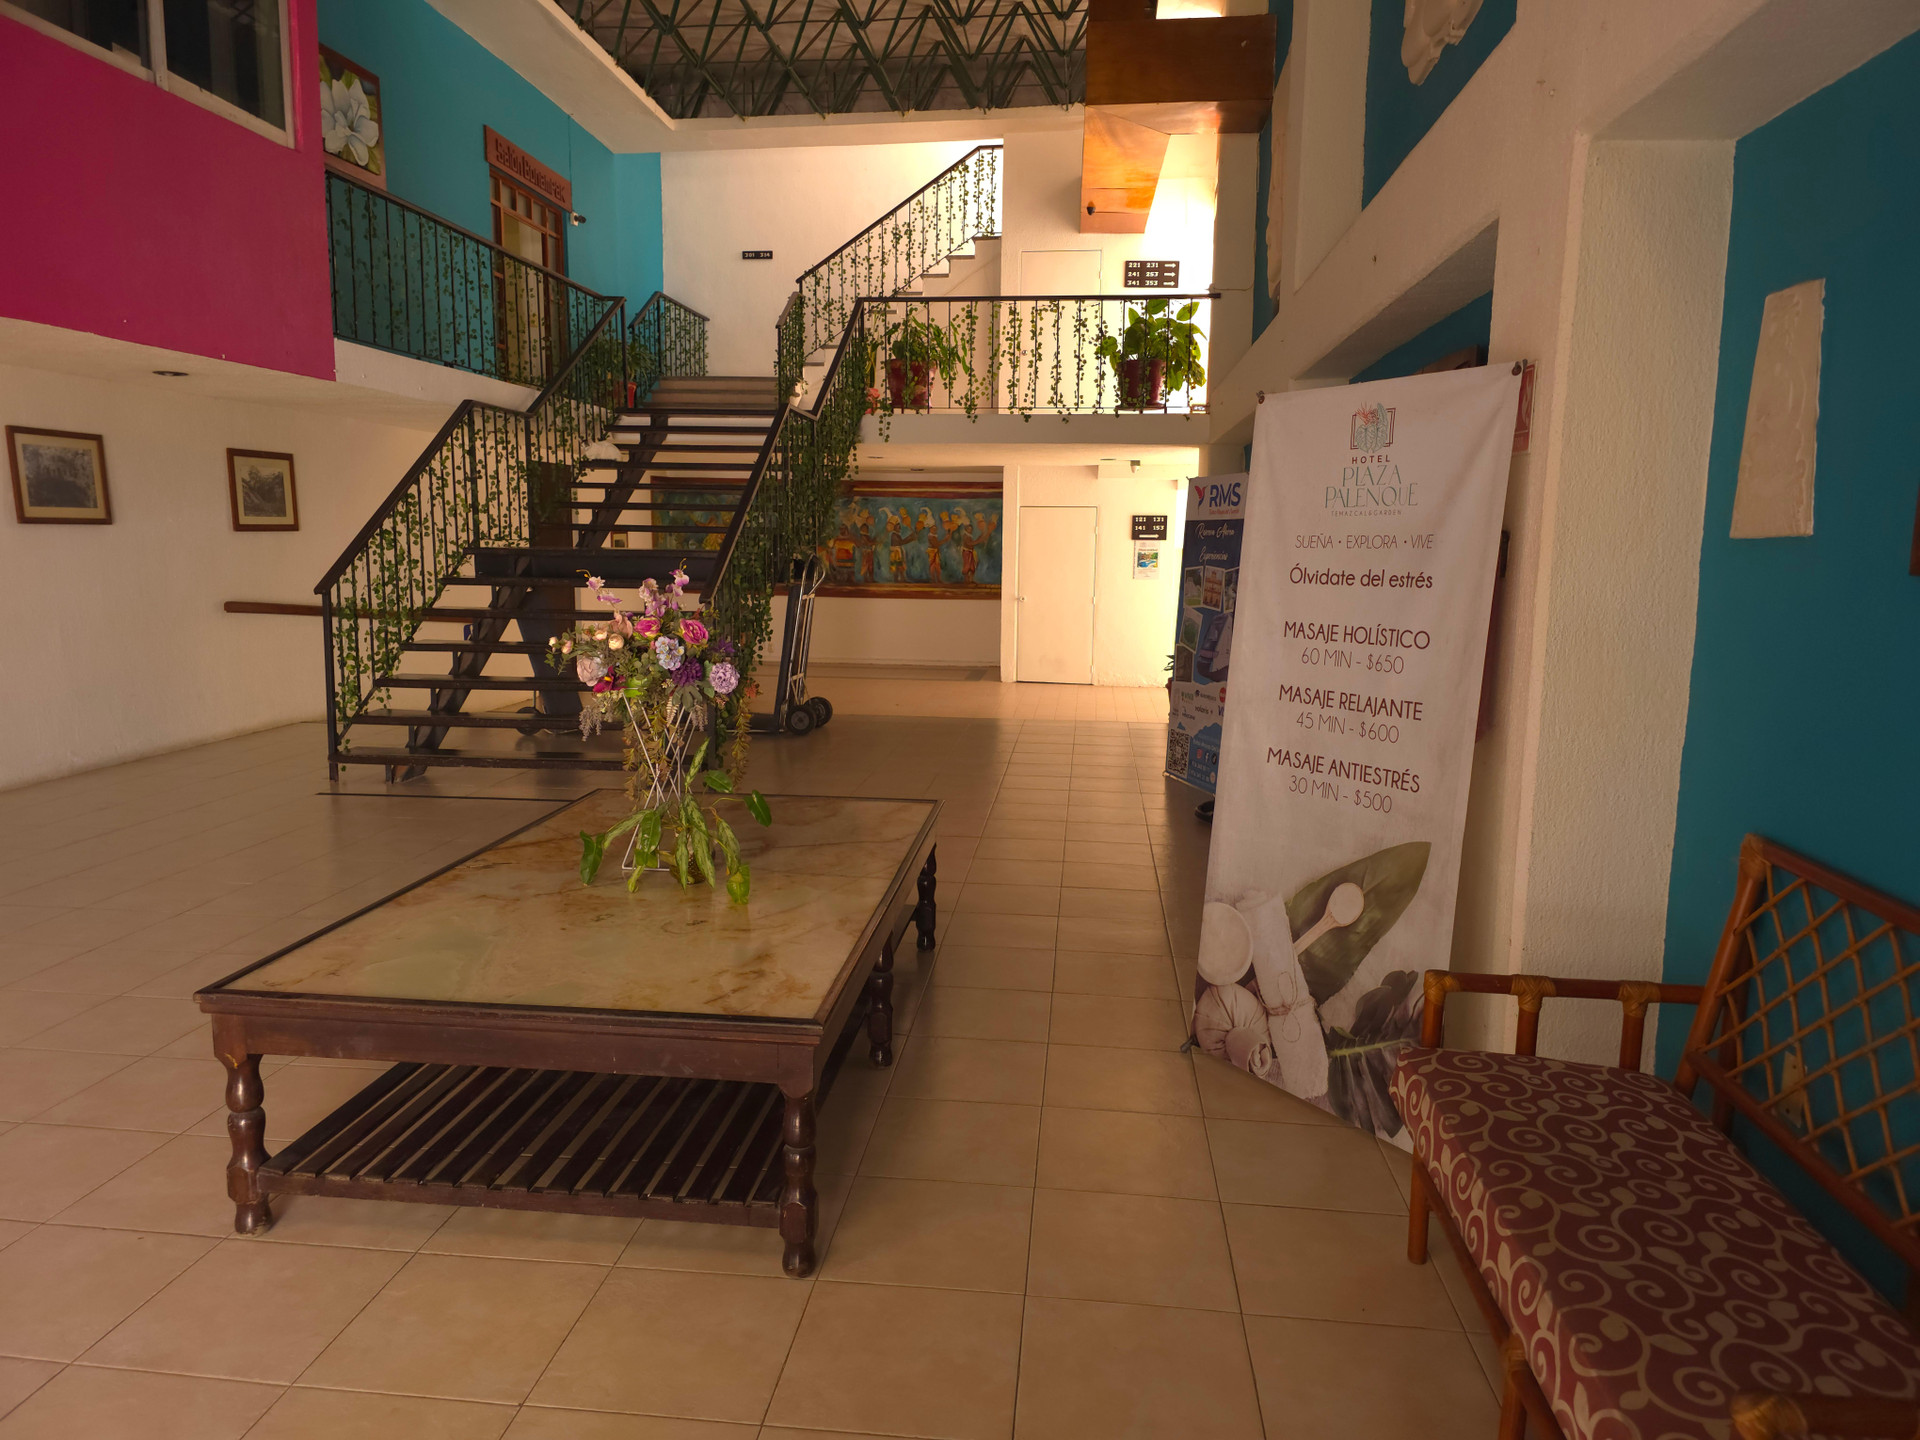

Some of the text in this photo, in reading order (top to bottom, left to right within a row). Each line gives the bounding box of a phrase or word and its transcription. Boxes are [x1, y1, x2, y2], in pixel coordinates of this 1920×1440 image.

[1351, 454, 1391, 464] HOTEL
[1342, 464, 1402, 487] PLAZA
[1209, 482, 1241, 507] RMS
[1325, 482, 1418, 509] PALENQUE
[1295, 533, 1434, 549] SUEÑA EXPLORA VIVE
[1289, 563, 1433, 589] Ólvidate del estrés
[1284, 621, 1431, 650] MASAJE HOLÍSTICO
[1301, 647, 1320, 665] 60
[1323, 649, 1352, 669] MIN
[1366, 653, 1404, 675] $650
[1279, 684, 1424, 721] MASAJE RELAJANTE
[1296, 711, 1314, 729] 45
[1318, 714, 1346, 735] MIN
[1359, 721, 1400, 744] $600
[1266, 747, 1420, 793] MASAJE ANTIESTRÉS
[1289, 775, 1308, 794] 30
[1311, 780, 1339, 802] MIN
[1354, 789, 1393, 814] $500
